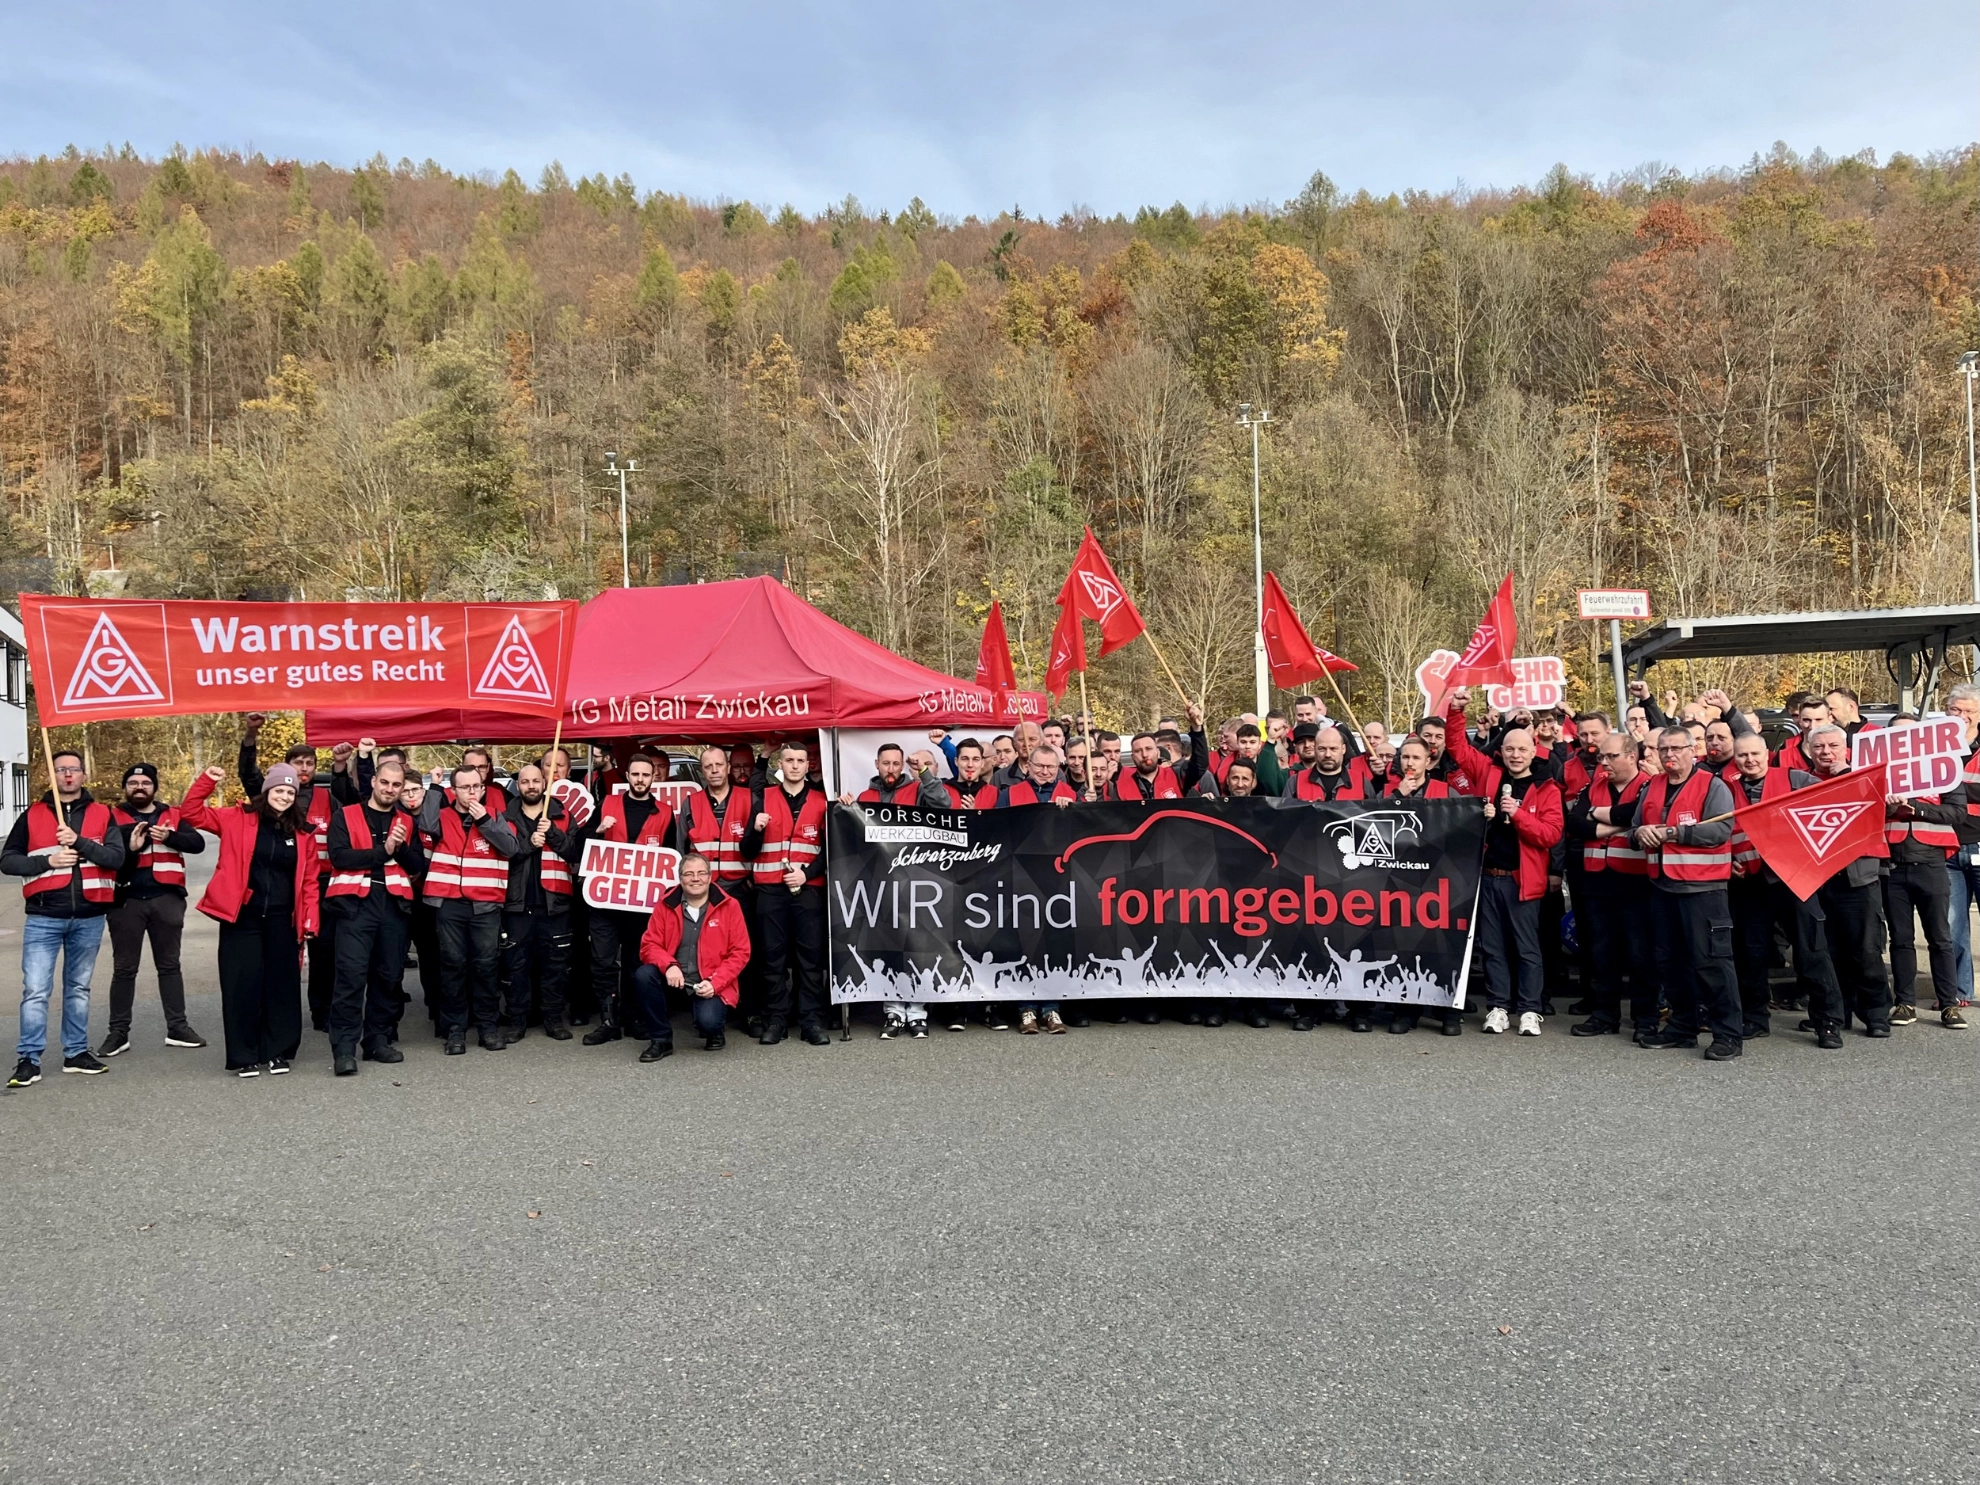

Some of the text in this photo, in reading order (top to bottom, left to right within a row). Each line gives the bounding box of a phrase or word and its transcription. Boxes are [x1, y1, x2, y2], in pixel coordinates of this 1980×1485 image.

[1584, 594, 1643, 604] Feuerwehrzufahrt
[190, 615, 447, 654] Warnstreik
[196, 660, 447, 688] unser gutes Recht
[1511, 660, 1561, 683] EHR
[572, 691, 809, 724] IG Metall Zwickau
[918, 691, 938, 713] IG
[941, 688, 985, 713] Metall
[1492, 683, 1558, 708] GELD
[1858, 722, 1962, 767] MEHR
[1886, 756, 1957, 795] ELD
[865, 808, 968, 829] PORSCHE
[867, 828, 966, 845] WERKZEUGBAU
[586, 845, 677, 880] MEHR
[888, 842, 1002, 874] Schwarzenberg
[1377, 860, 1430, 870] Zwickau
[588, 875, 667, 907] GELD
[834, 875, 1468, 937] WIR sind formgebend.
